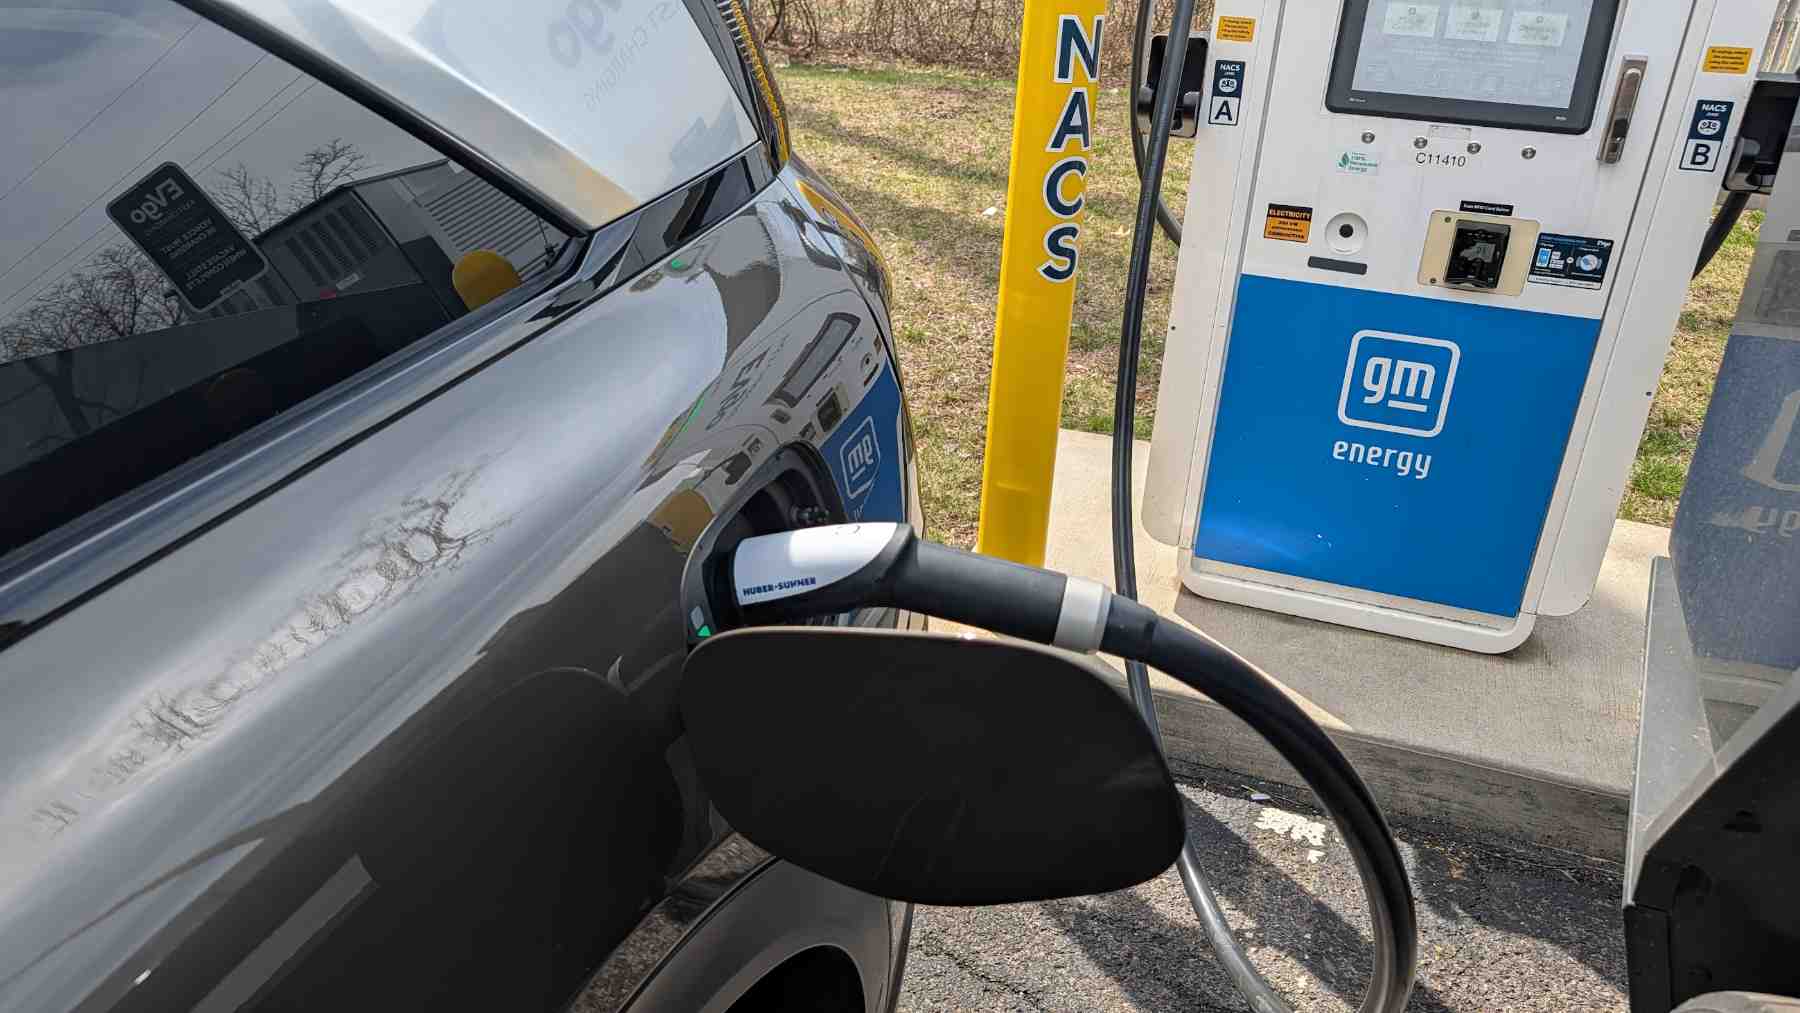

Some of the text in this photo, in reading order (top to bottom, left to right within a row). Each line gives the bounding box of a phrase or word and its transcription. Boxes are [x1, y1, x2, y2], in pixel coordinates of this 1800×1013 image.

[1219, 63, 1241, 71] NACS
[1214, 100, 1233, 121] A
[1701, 103, 1728, 112] NACS
[1038, 15, 1105, 283] NACS
[1690, 143, 1711, 165] B
[1415, 152, 1466, 168] C11410
[1269, 208, 1311, 220] ELECTRICITY
[1363, 356, 1436, 405] gm
[1332, 440, 1433, 480] energy
